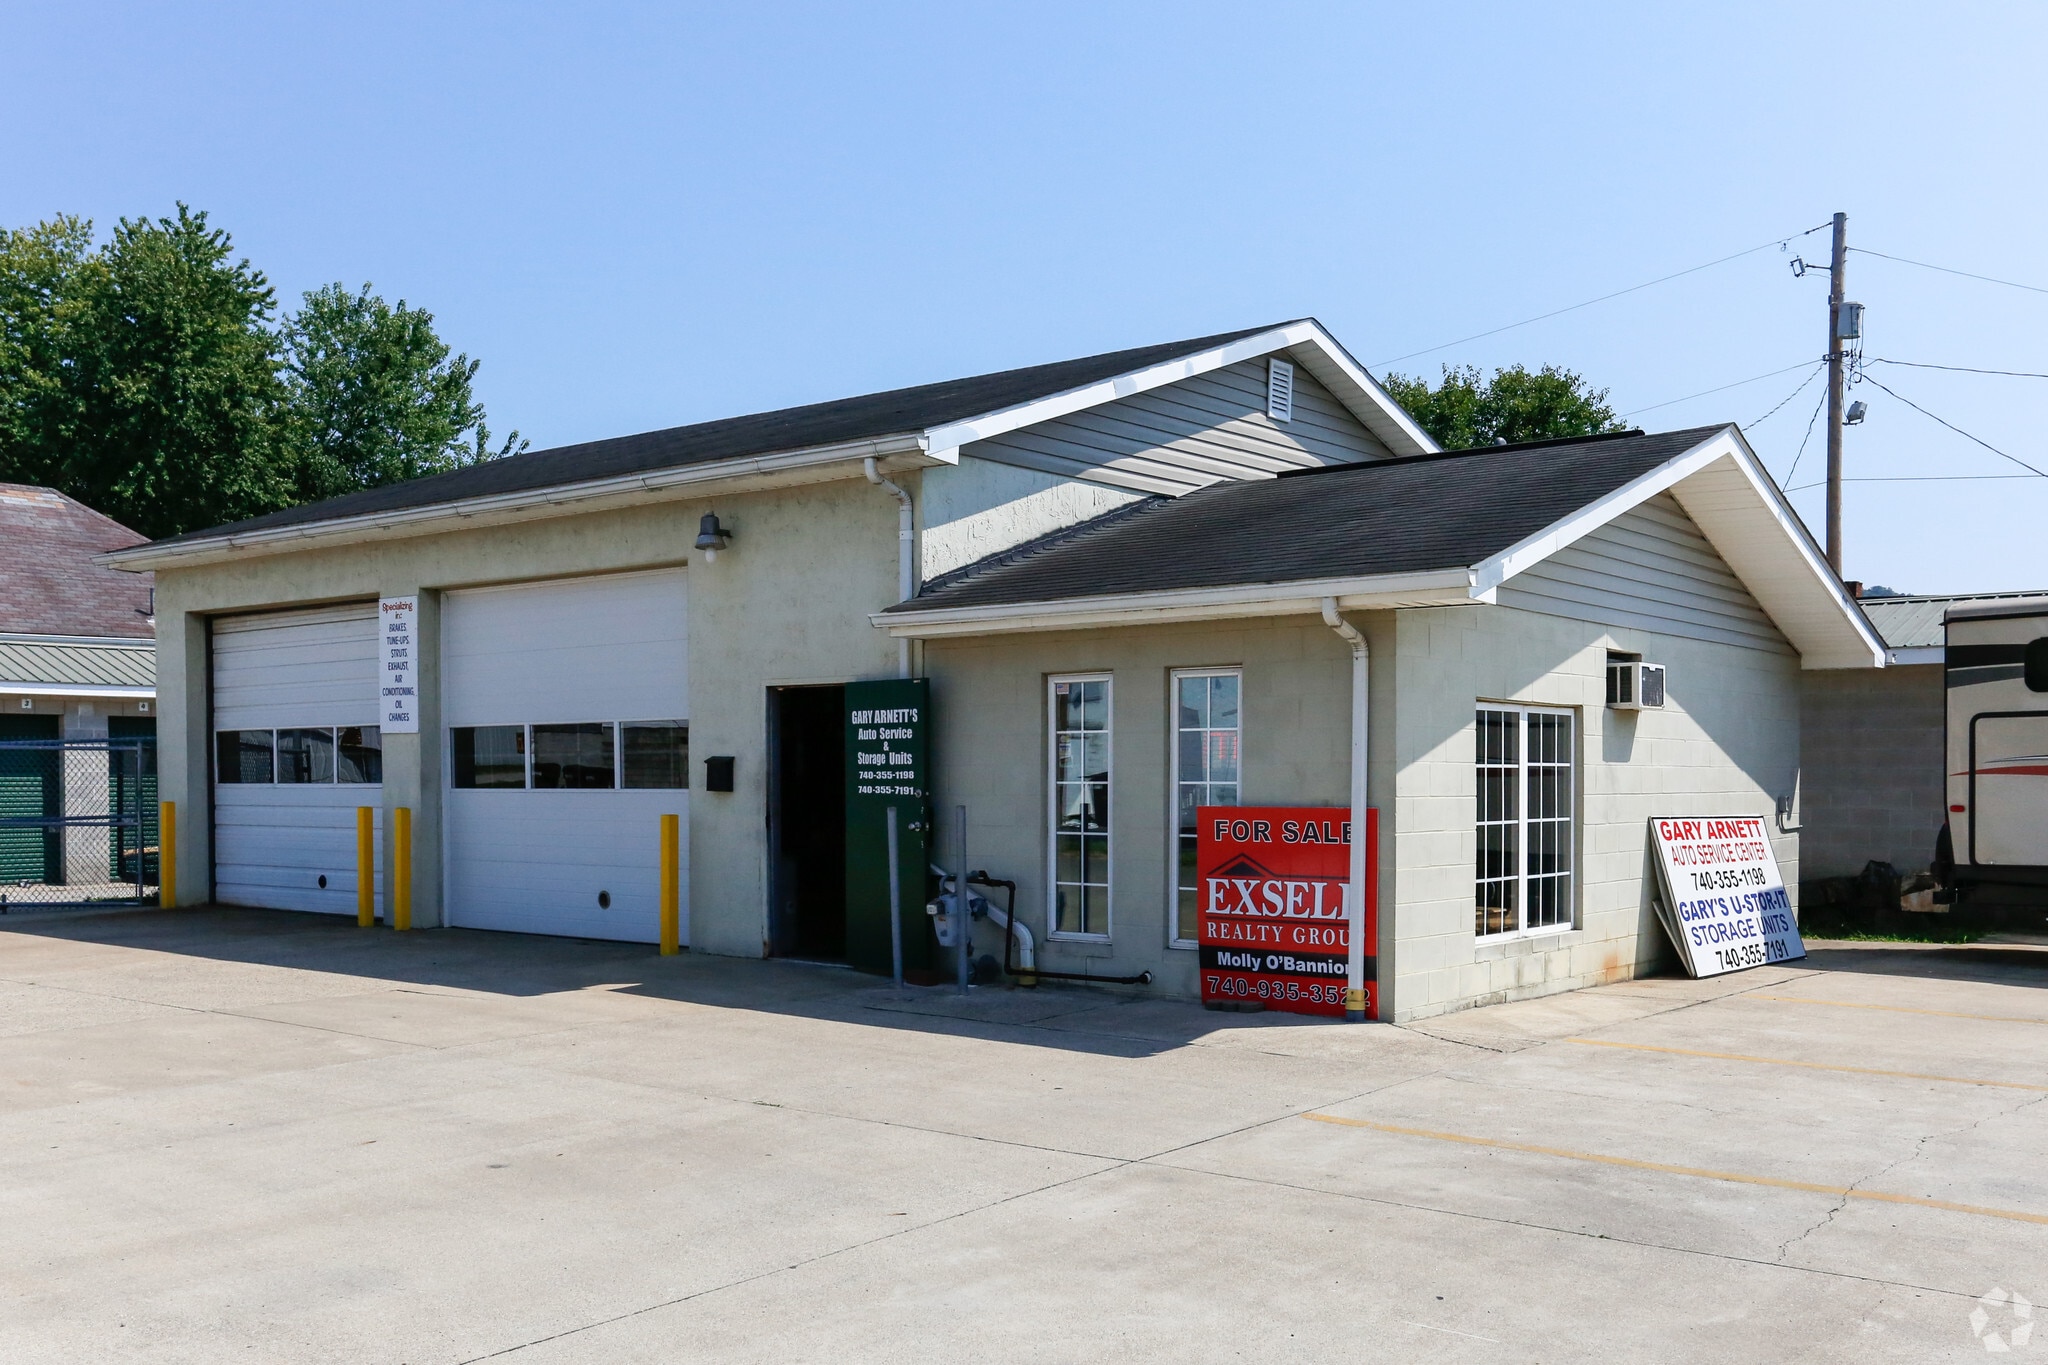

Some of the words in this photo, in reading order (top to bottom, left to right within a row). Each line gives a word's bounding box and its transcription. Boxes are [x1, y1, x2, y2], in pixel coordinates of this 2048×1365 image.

[382, 601, 413, 614] Specializing
[389, 712, 409, 721] CHANGES
[851, 710, 873, 724] GARY
[874, 708, 918, 724] ARNETT'S
[858, 728, 877, 740] Auto
[879, 727, 913, 739] Service
[883, 741, 889, 751] &
[857, 751, 886, 766] Storage
[889, 751, 913, 765] Units
[859, 771, 914, 779] 740-355-1198
[858, 785, 914, 795] 740-355-7191
[1214, 819, 1272, 843] FOR
[1282, 821, 1351, 844] SALE
[1660, 821, 1702, 841] GARY
[1707, 820, 1761, 839] ARNETT
[1671, 844, 1697, 866] AUTO
[1697, 843, 1736, 864] SERVICE
[1735, 842, 1768, 861] CENTER
[1691, 868, 1766, 891] 740-355-1198
[1679, 897, 1729, 922] GARY'S
[1730, 890, 1788, 915] U-STOR-IT
[1207, 921, 1284, 943] REALTY
[1293, 928, 1350, 946] GROU
[1691, 918, 1757, 946] STORAGE
[1756, 913, 1789, 936] UNITS
[1217, 951, 1261, 972] Molly
[1715, 938, 1790, 970] 740-355-7191
